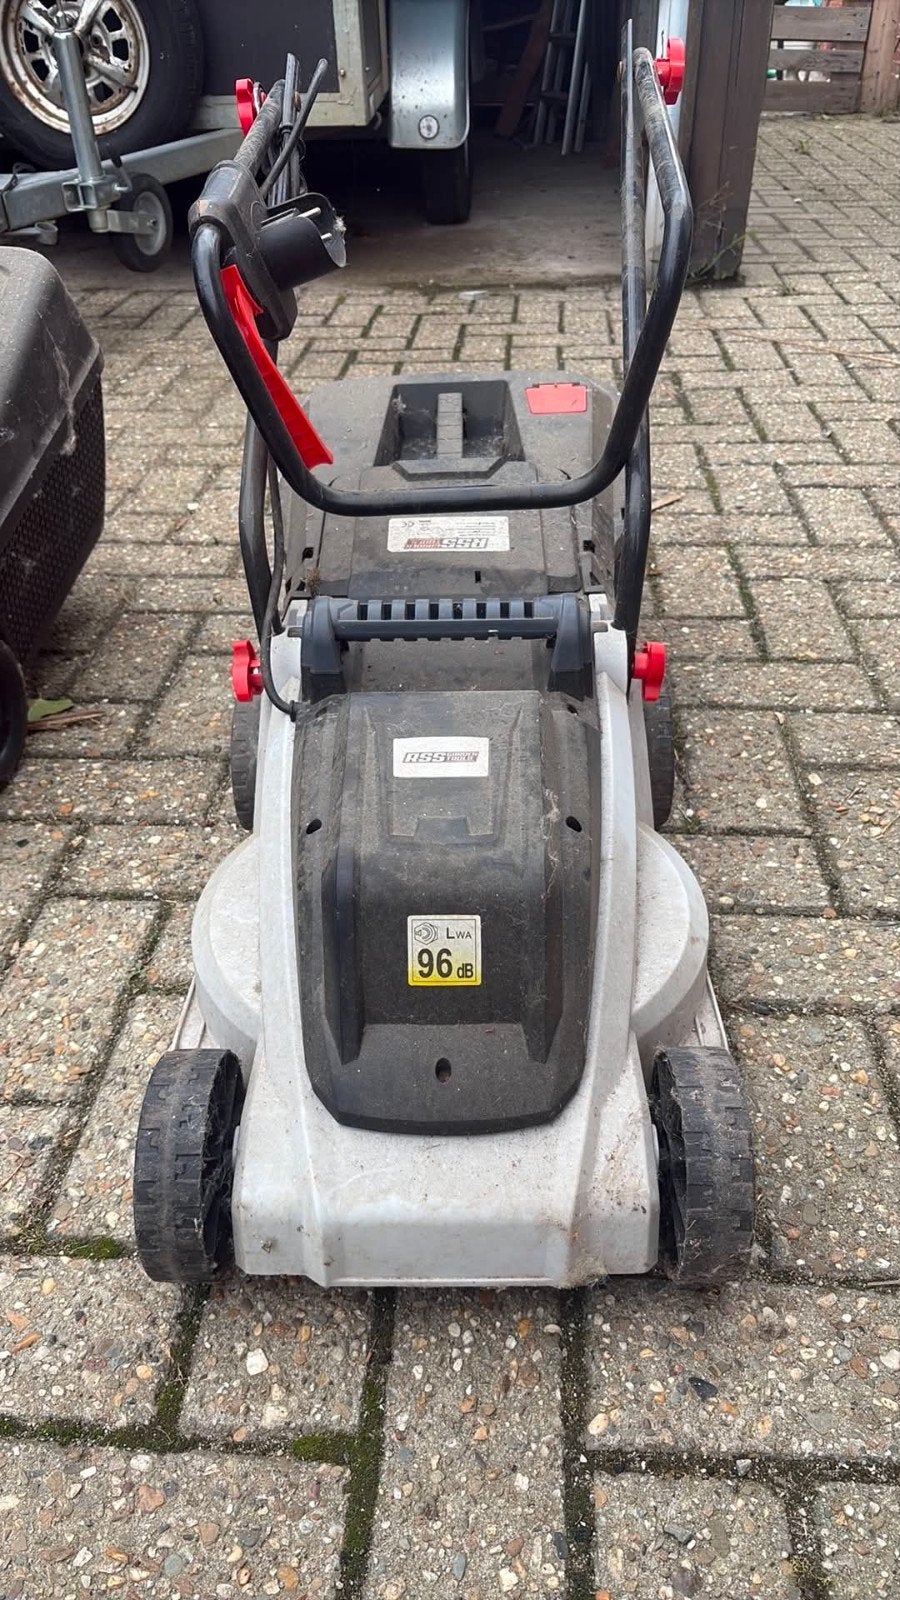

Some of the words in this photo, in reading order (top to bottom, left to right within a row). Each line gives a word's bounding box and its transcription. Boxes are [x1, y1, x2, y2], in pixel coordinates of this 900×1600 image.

[441, 538, 488, 548] RSS
[404, 752, 447, 763] RSS
[417, 948, 453, 978] 96
[457, 963, 474, 978] dB
